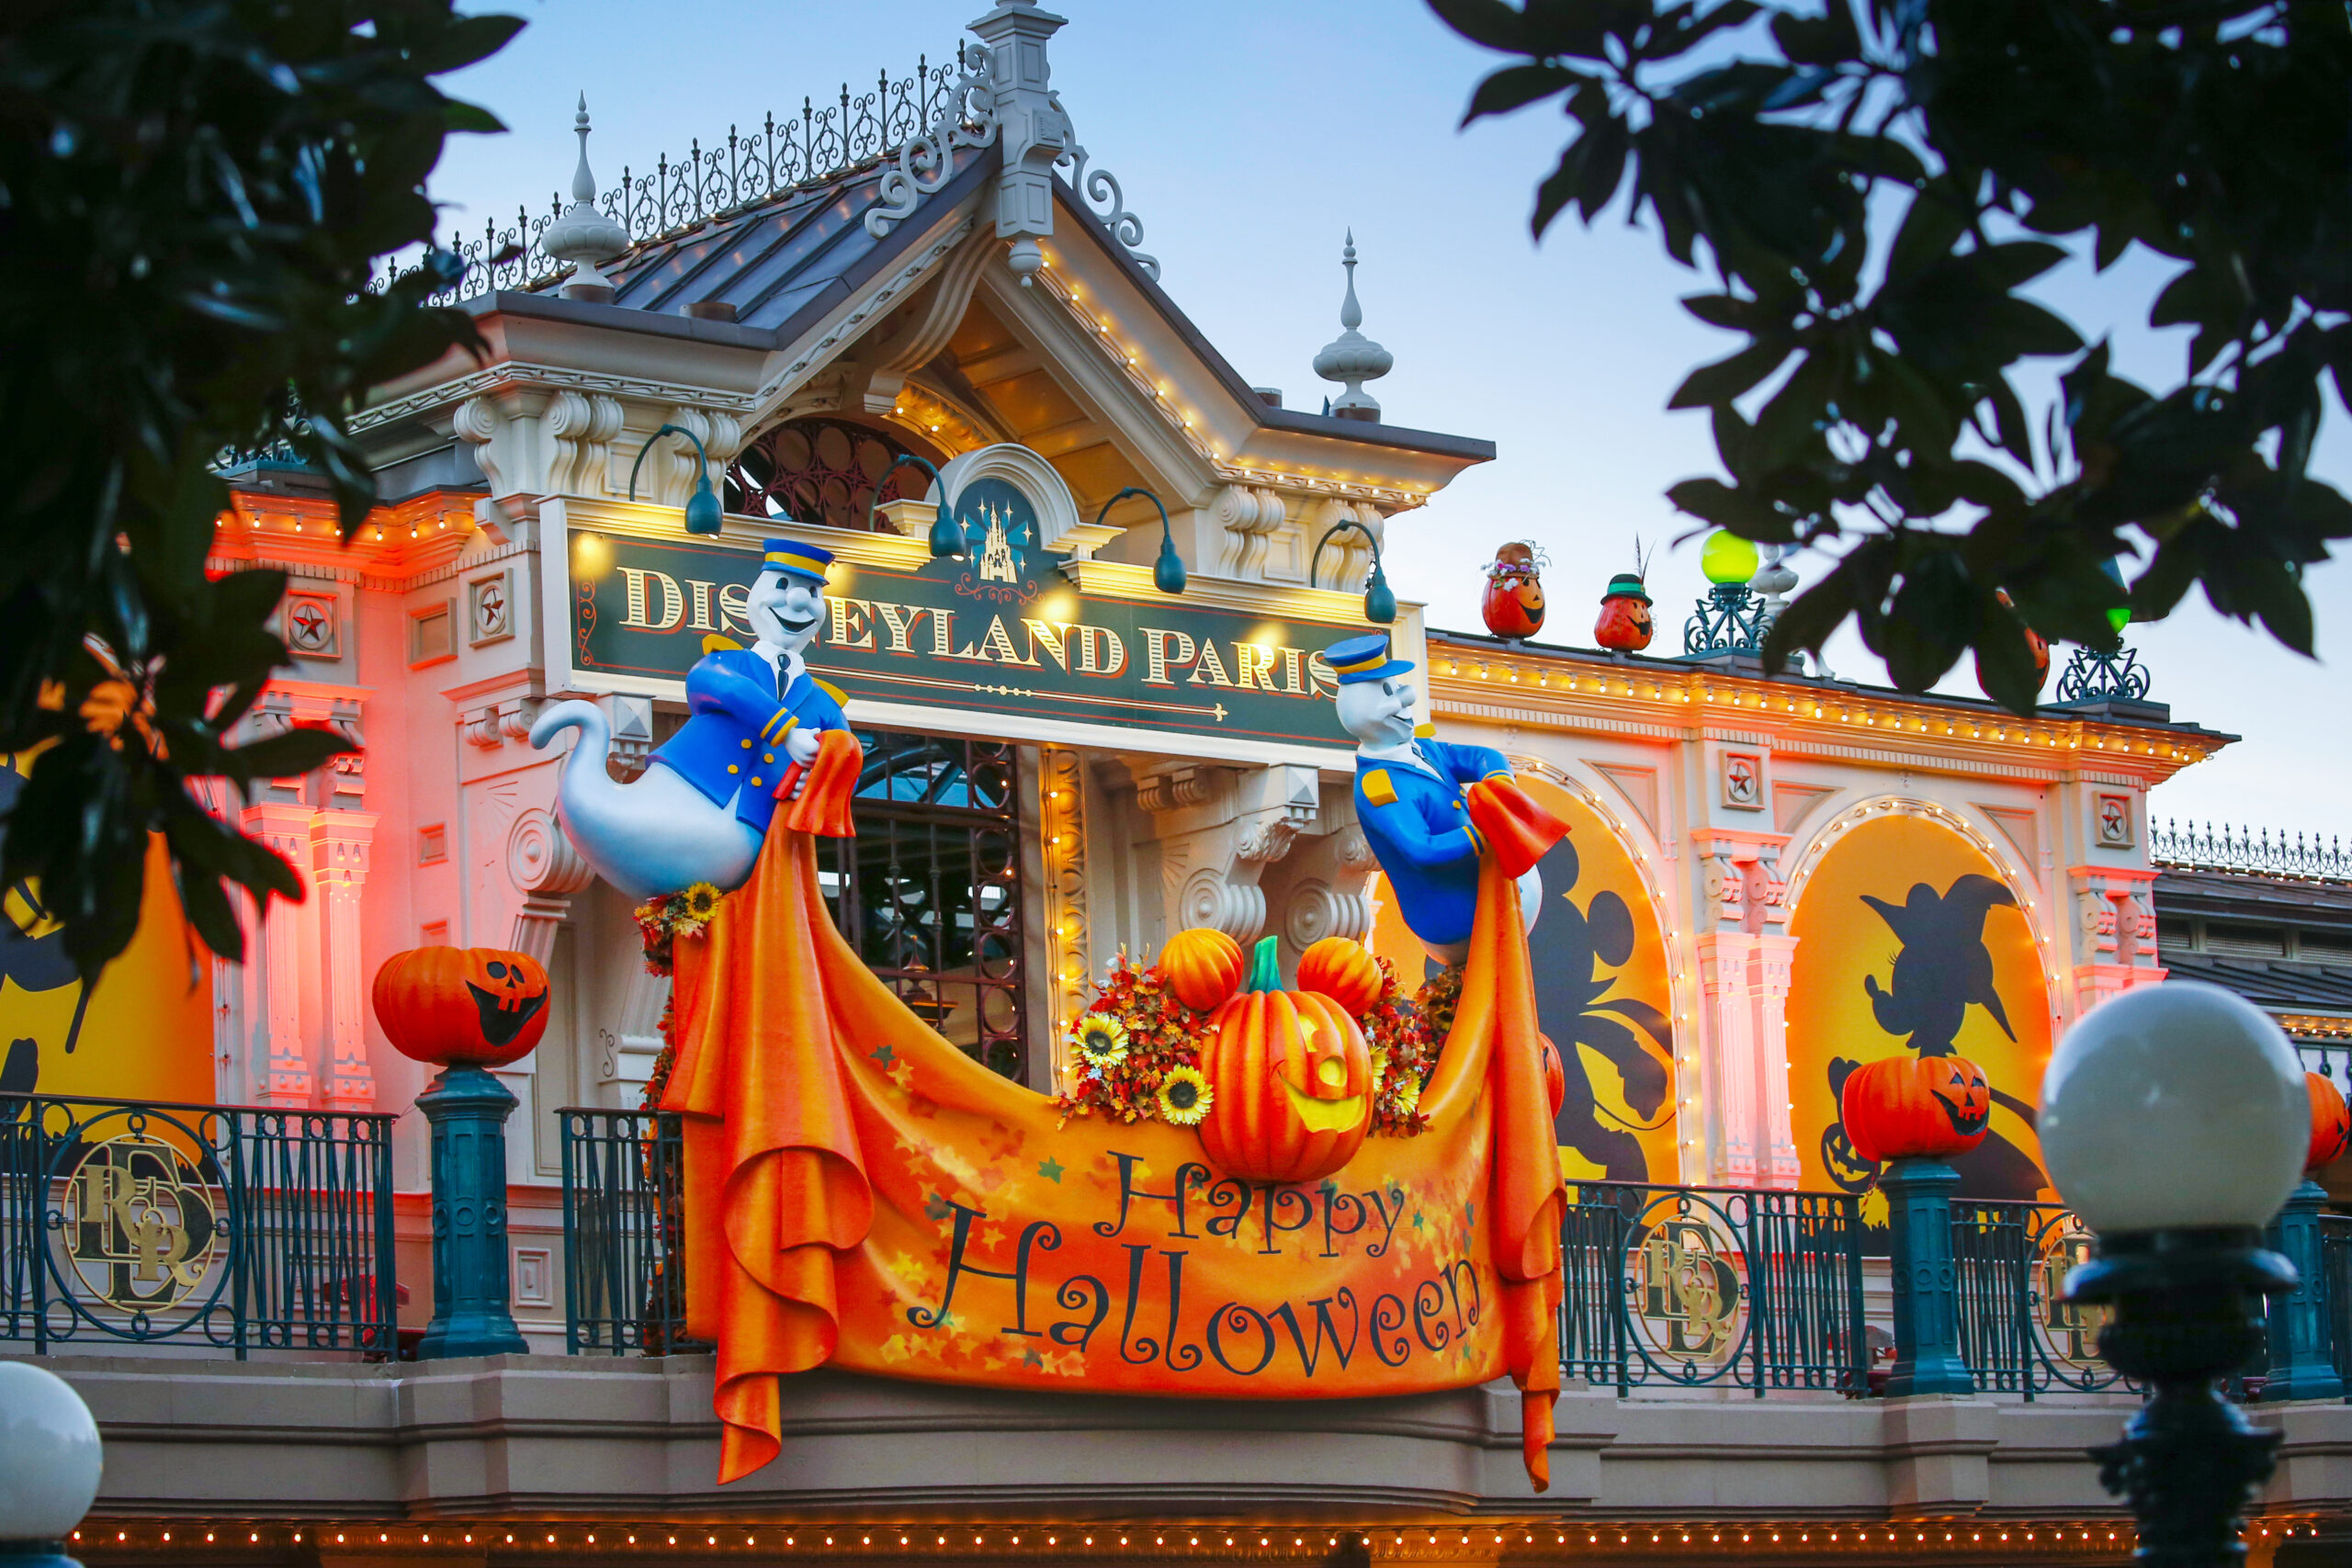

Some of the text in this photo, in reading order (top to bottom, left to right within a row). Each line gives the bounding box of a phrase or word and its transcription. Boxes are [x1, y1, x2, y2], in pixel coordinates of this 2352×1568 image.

[616, 566, 1340, 699] DISEYLAND PARIS
[1092, 1149, 1406, 1258] Happy
[906, 1199, 1481, 1378] Halloween
